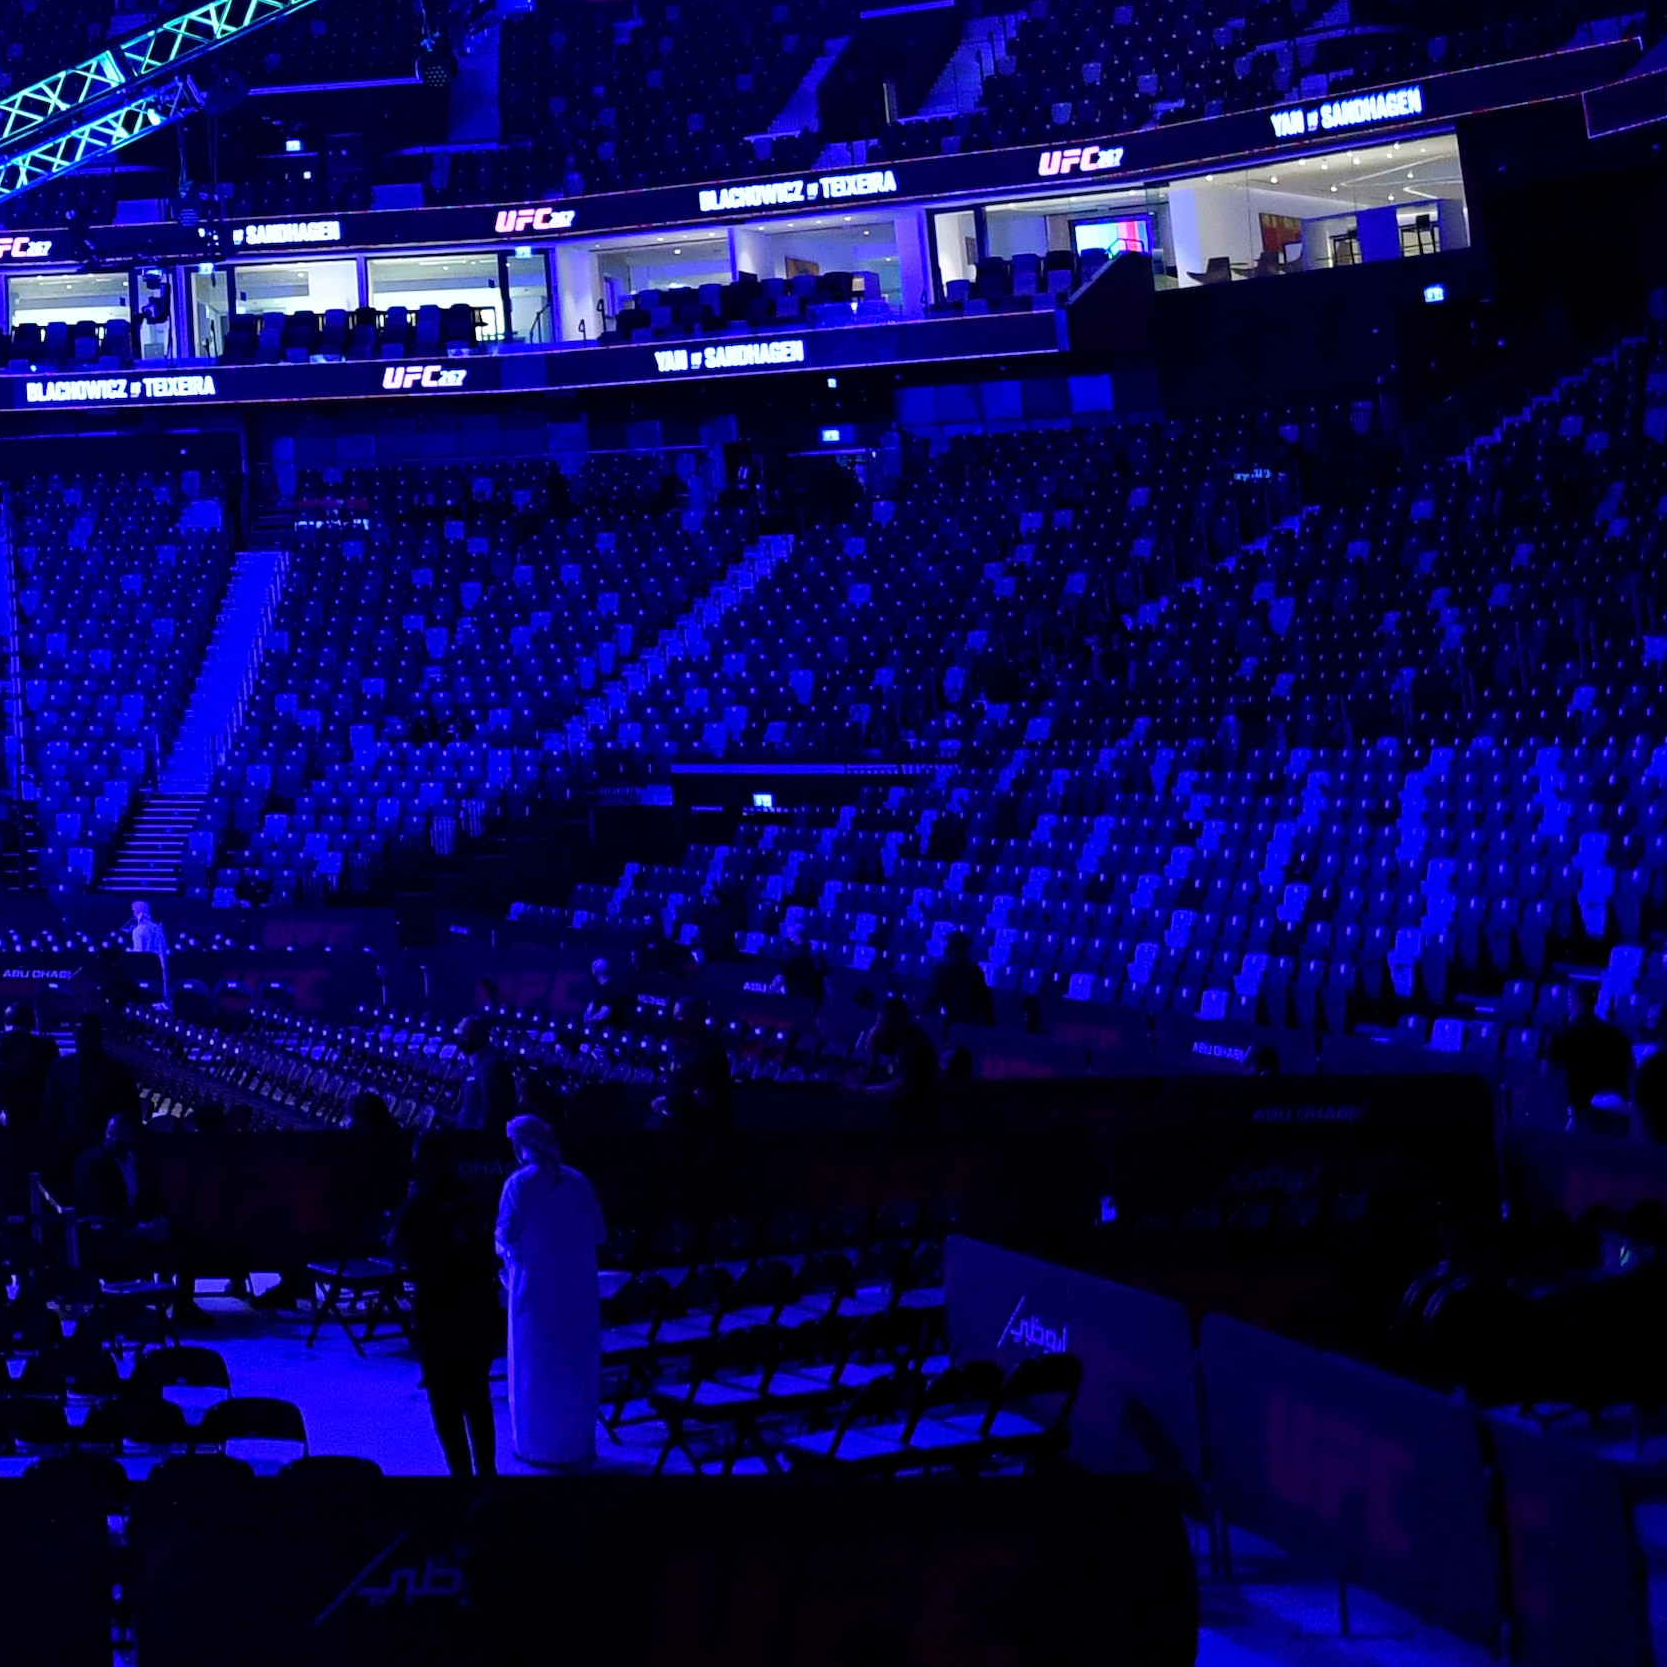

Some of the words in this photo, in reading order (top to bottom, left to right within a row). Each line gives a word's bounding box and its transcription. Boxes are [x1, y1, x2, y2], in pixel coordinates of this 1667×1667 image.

[1270, 108, 1304, 137] YAN
[1320, 85, 1423, 129] SANDHAGEN
[1038, 146, 1100, 177] UFC
[819, 170, 897, 199] TEIXEIRA
[245, 221, 341, 245] SANDHAGEN
[495, 208, 552, 233] UFC
[654, 349, 688, 372] YAN
[704, 340, 804, 368] SANDHAGEN
[142, 375, 216, 397] TEIXEIRA
[382, 365, 442, 390] UFC
